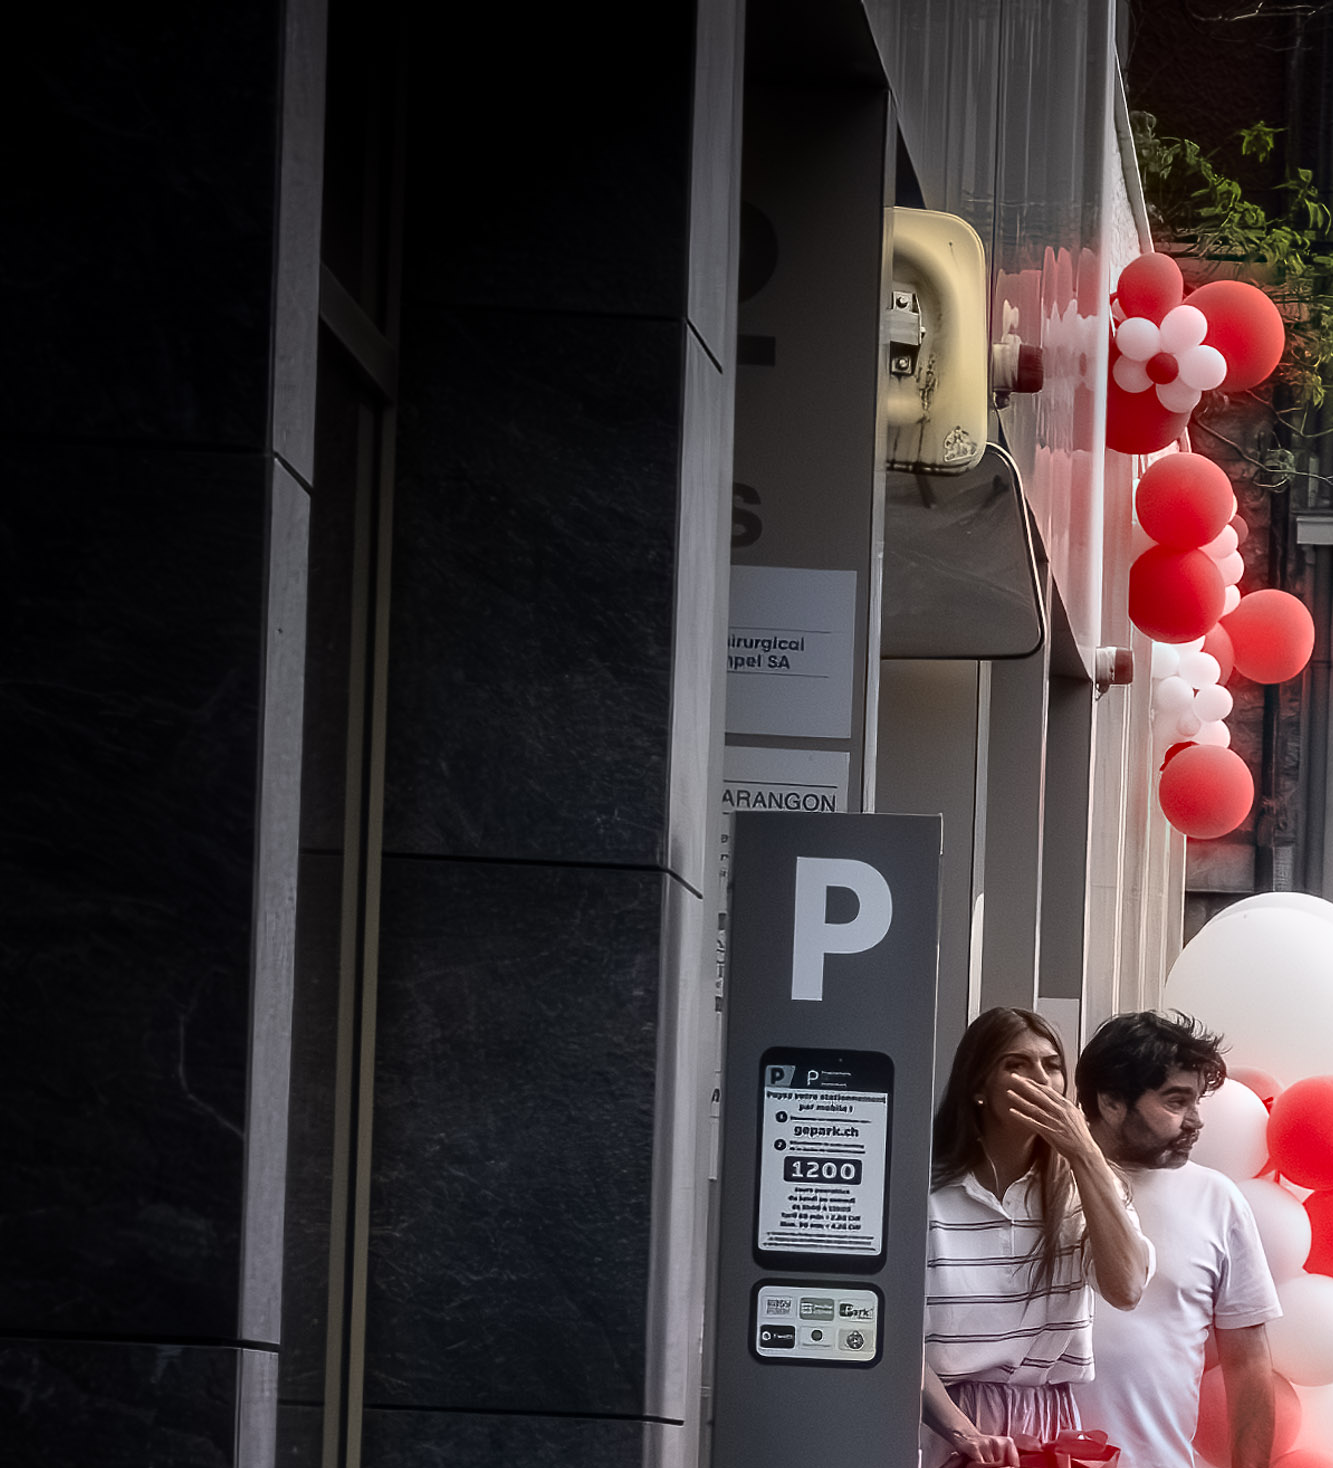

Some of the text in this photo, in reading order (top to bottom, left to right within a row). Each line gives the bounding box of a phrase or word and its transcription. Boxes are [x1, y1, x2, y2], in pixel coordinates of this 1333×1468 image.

[767, 655, 791, 670] SA
[791, 857, 894, 1001] P
[794, 1125, 860, 1138] gepark.ch
[791, 1160, 856, 1180] 1200
